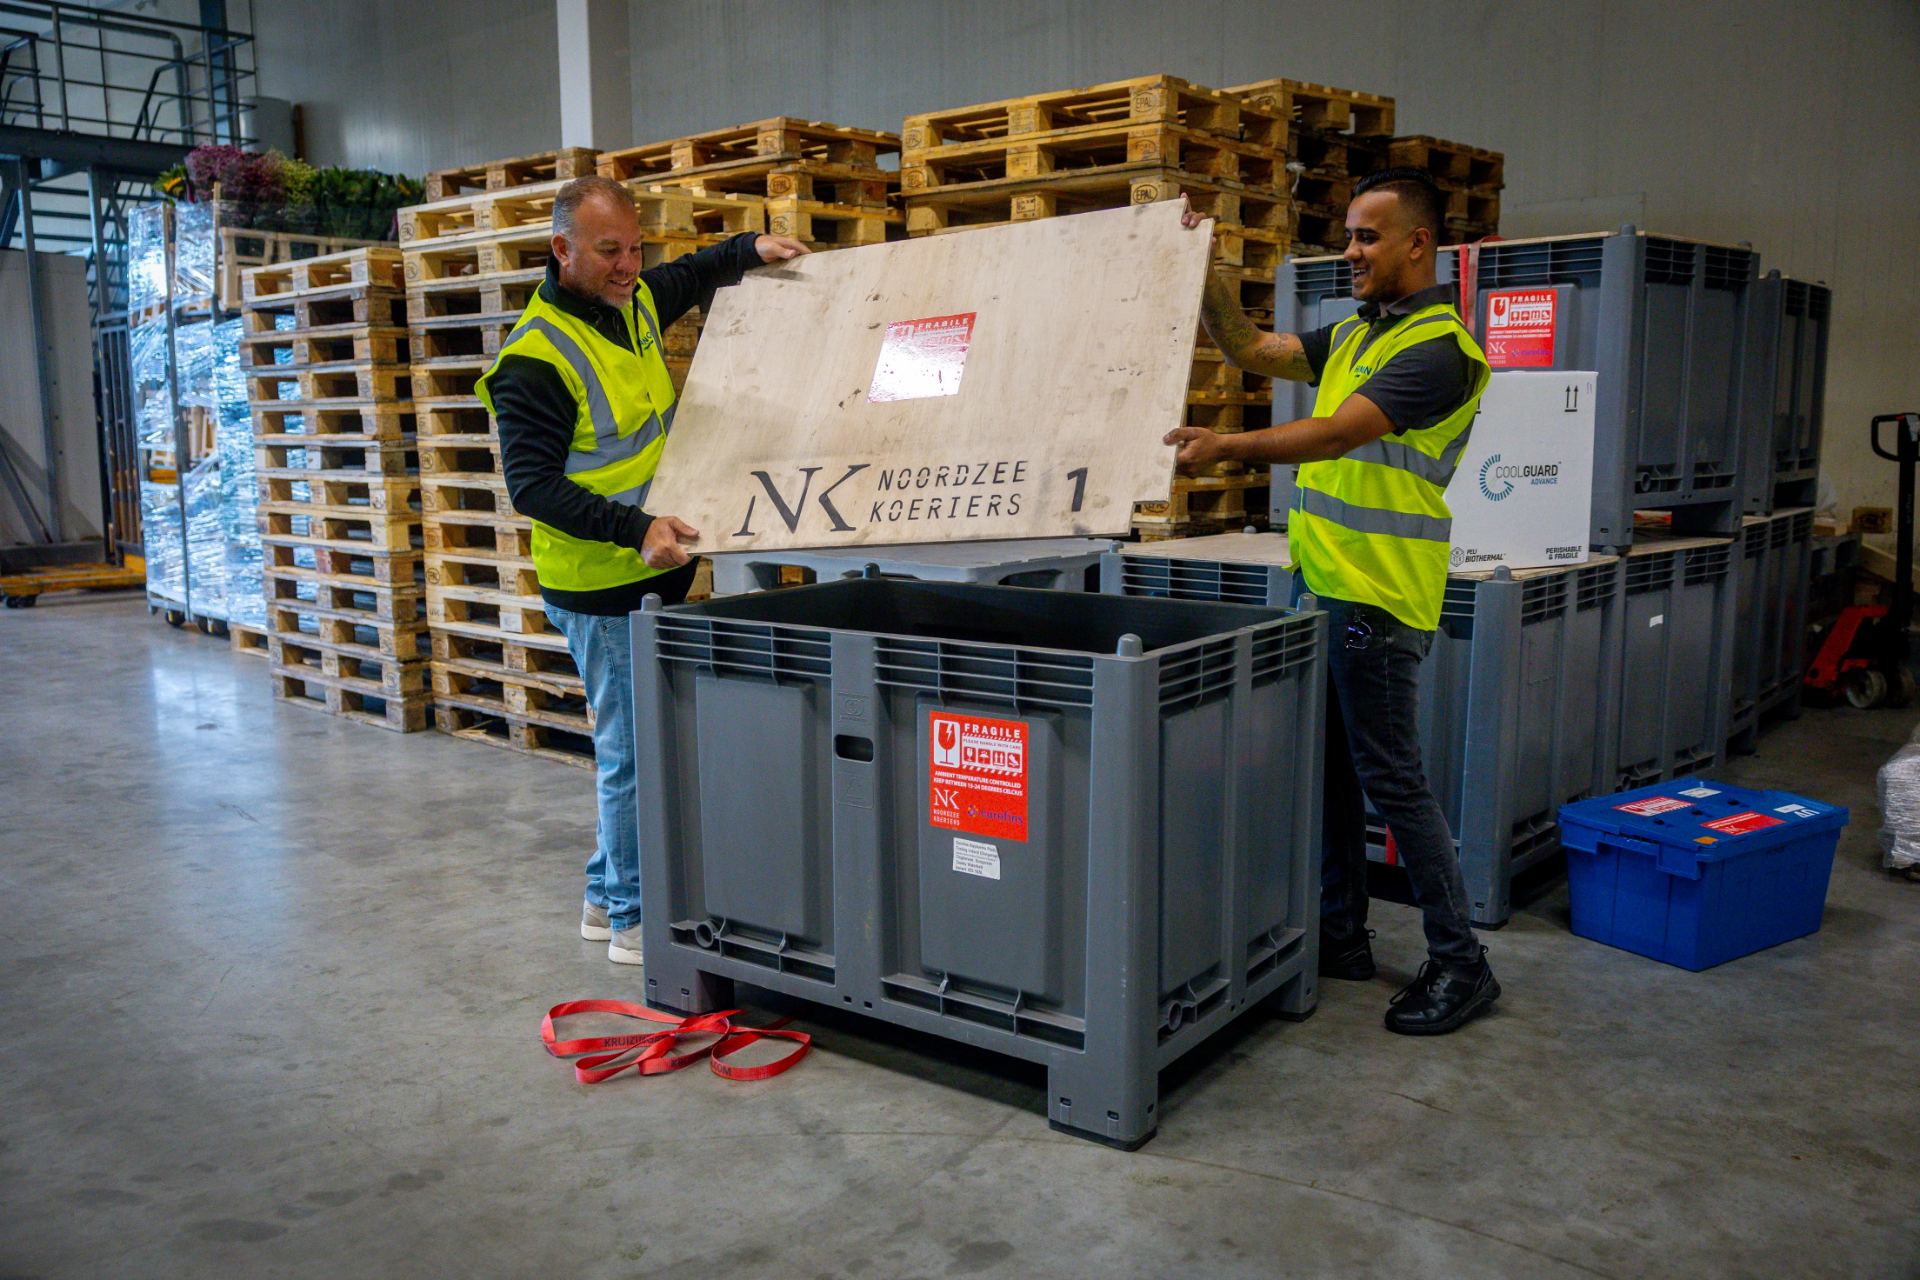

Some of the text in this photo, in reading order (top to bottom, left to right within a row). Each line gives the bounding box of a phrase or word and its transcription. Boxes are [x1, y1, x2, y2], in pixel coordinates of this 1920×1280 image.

[1512, 294, 1552, 302] FRAGILE
[918, 317, 968, 329] FRAGILE
[1488, 342, 1506, 354] NK
[878, 460, 1028, 491] NOORDZEE
[1530, 477, 1558, 485] ADVANCE
[1066, 467, 1088, 513] 1
[732, 463, 871, 536] NK
[869, 493, 1022, 523] KOERIERS
[1545, 545, 1582, 554] PERISHABLE
[1465, 553, 1503, 562] BIOTHERMAL
[1554, 552, 1578, 560] FRAGILE
[964, 723, 1020, 739] FRAGILE
[945, 778, 967, 788] BETWEEN
[989, 778, 1021, 789] CONTROLLED
[933, 787, 960, 810] NK
[933, 808, 960, 818] NOORDZEE
[981, 808, 1023, 826] eurofins
